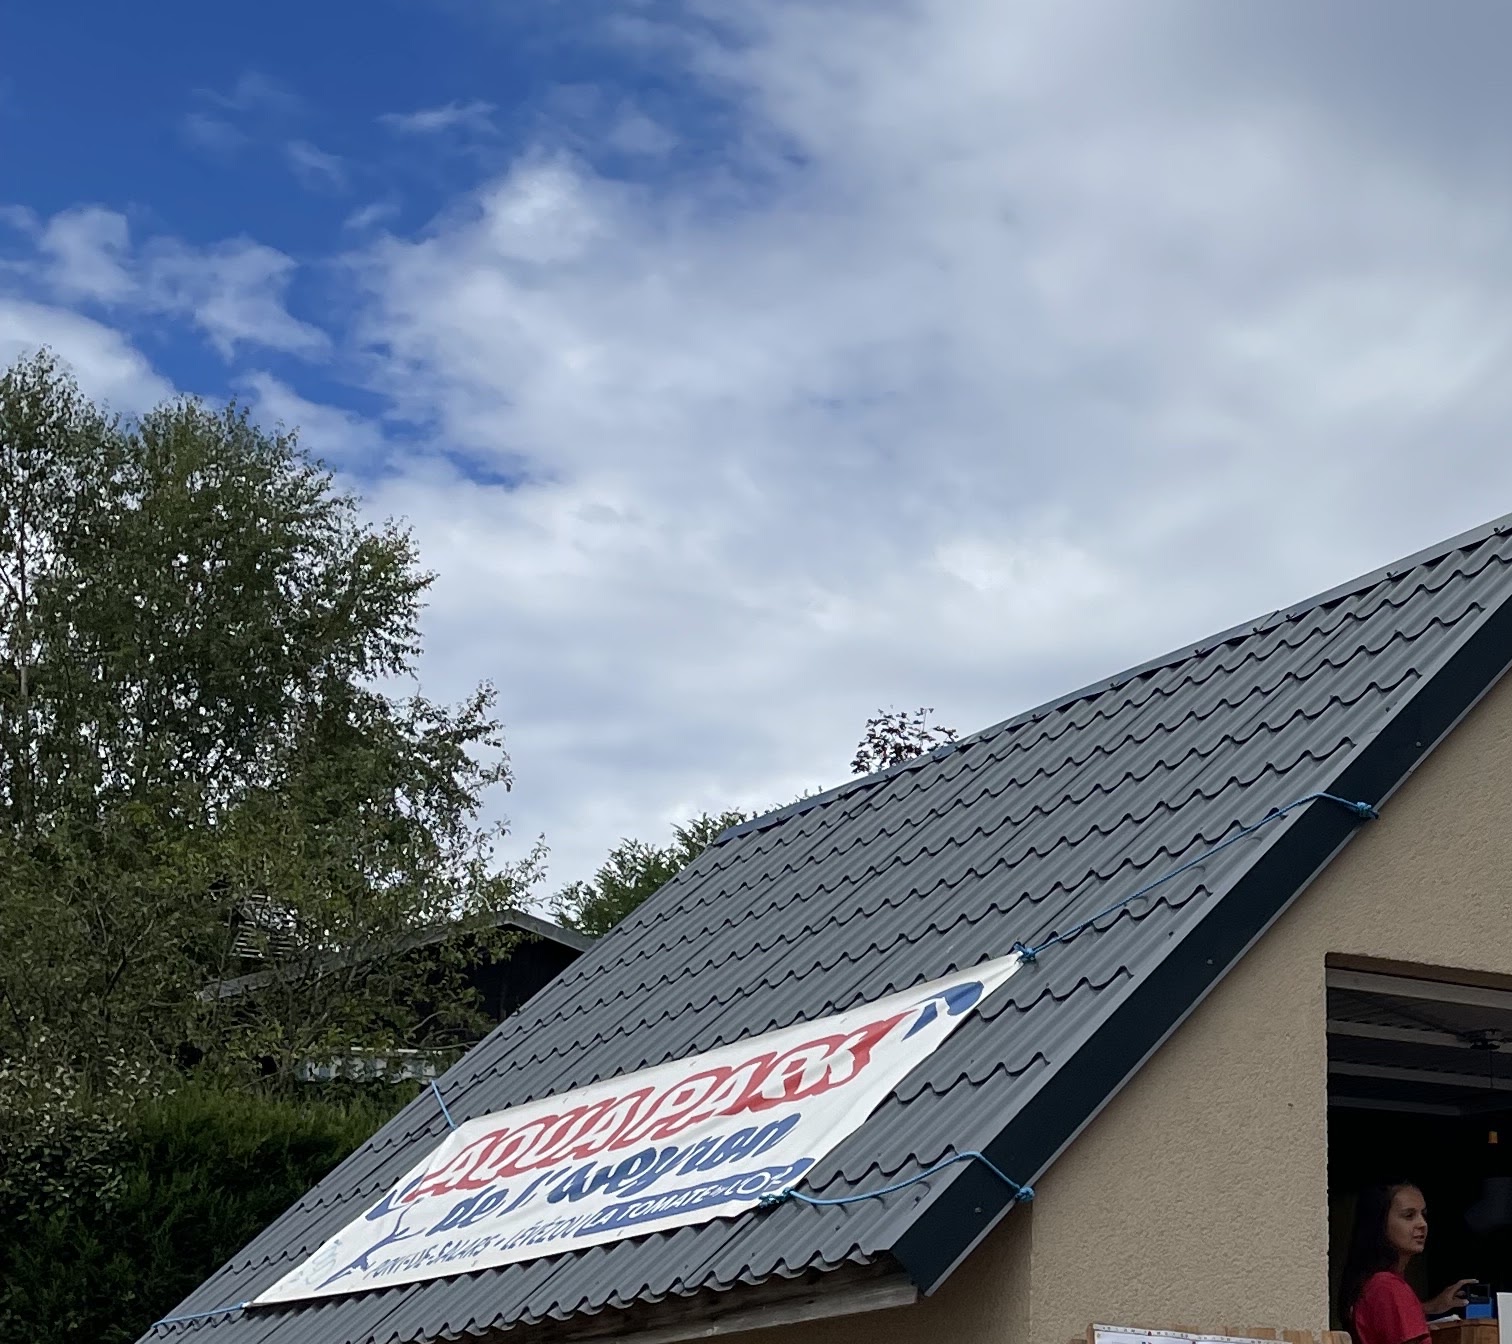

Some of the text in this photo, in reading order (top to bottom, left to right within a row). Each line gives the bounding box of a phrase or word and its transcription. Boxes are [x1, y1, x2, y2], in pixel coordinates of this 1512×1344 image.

[401, 1010, 917, 1203] AQUA PARK
[425, 1185, 509, 1236] de
[582, 1208, 616, 1229] LA
[617, 1185, 719, 1221] TOMATE
